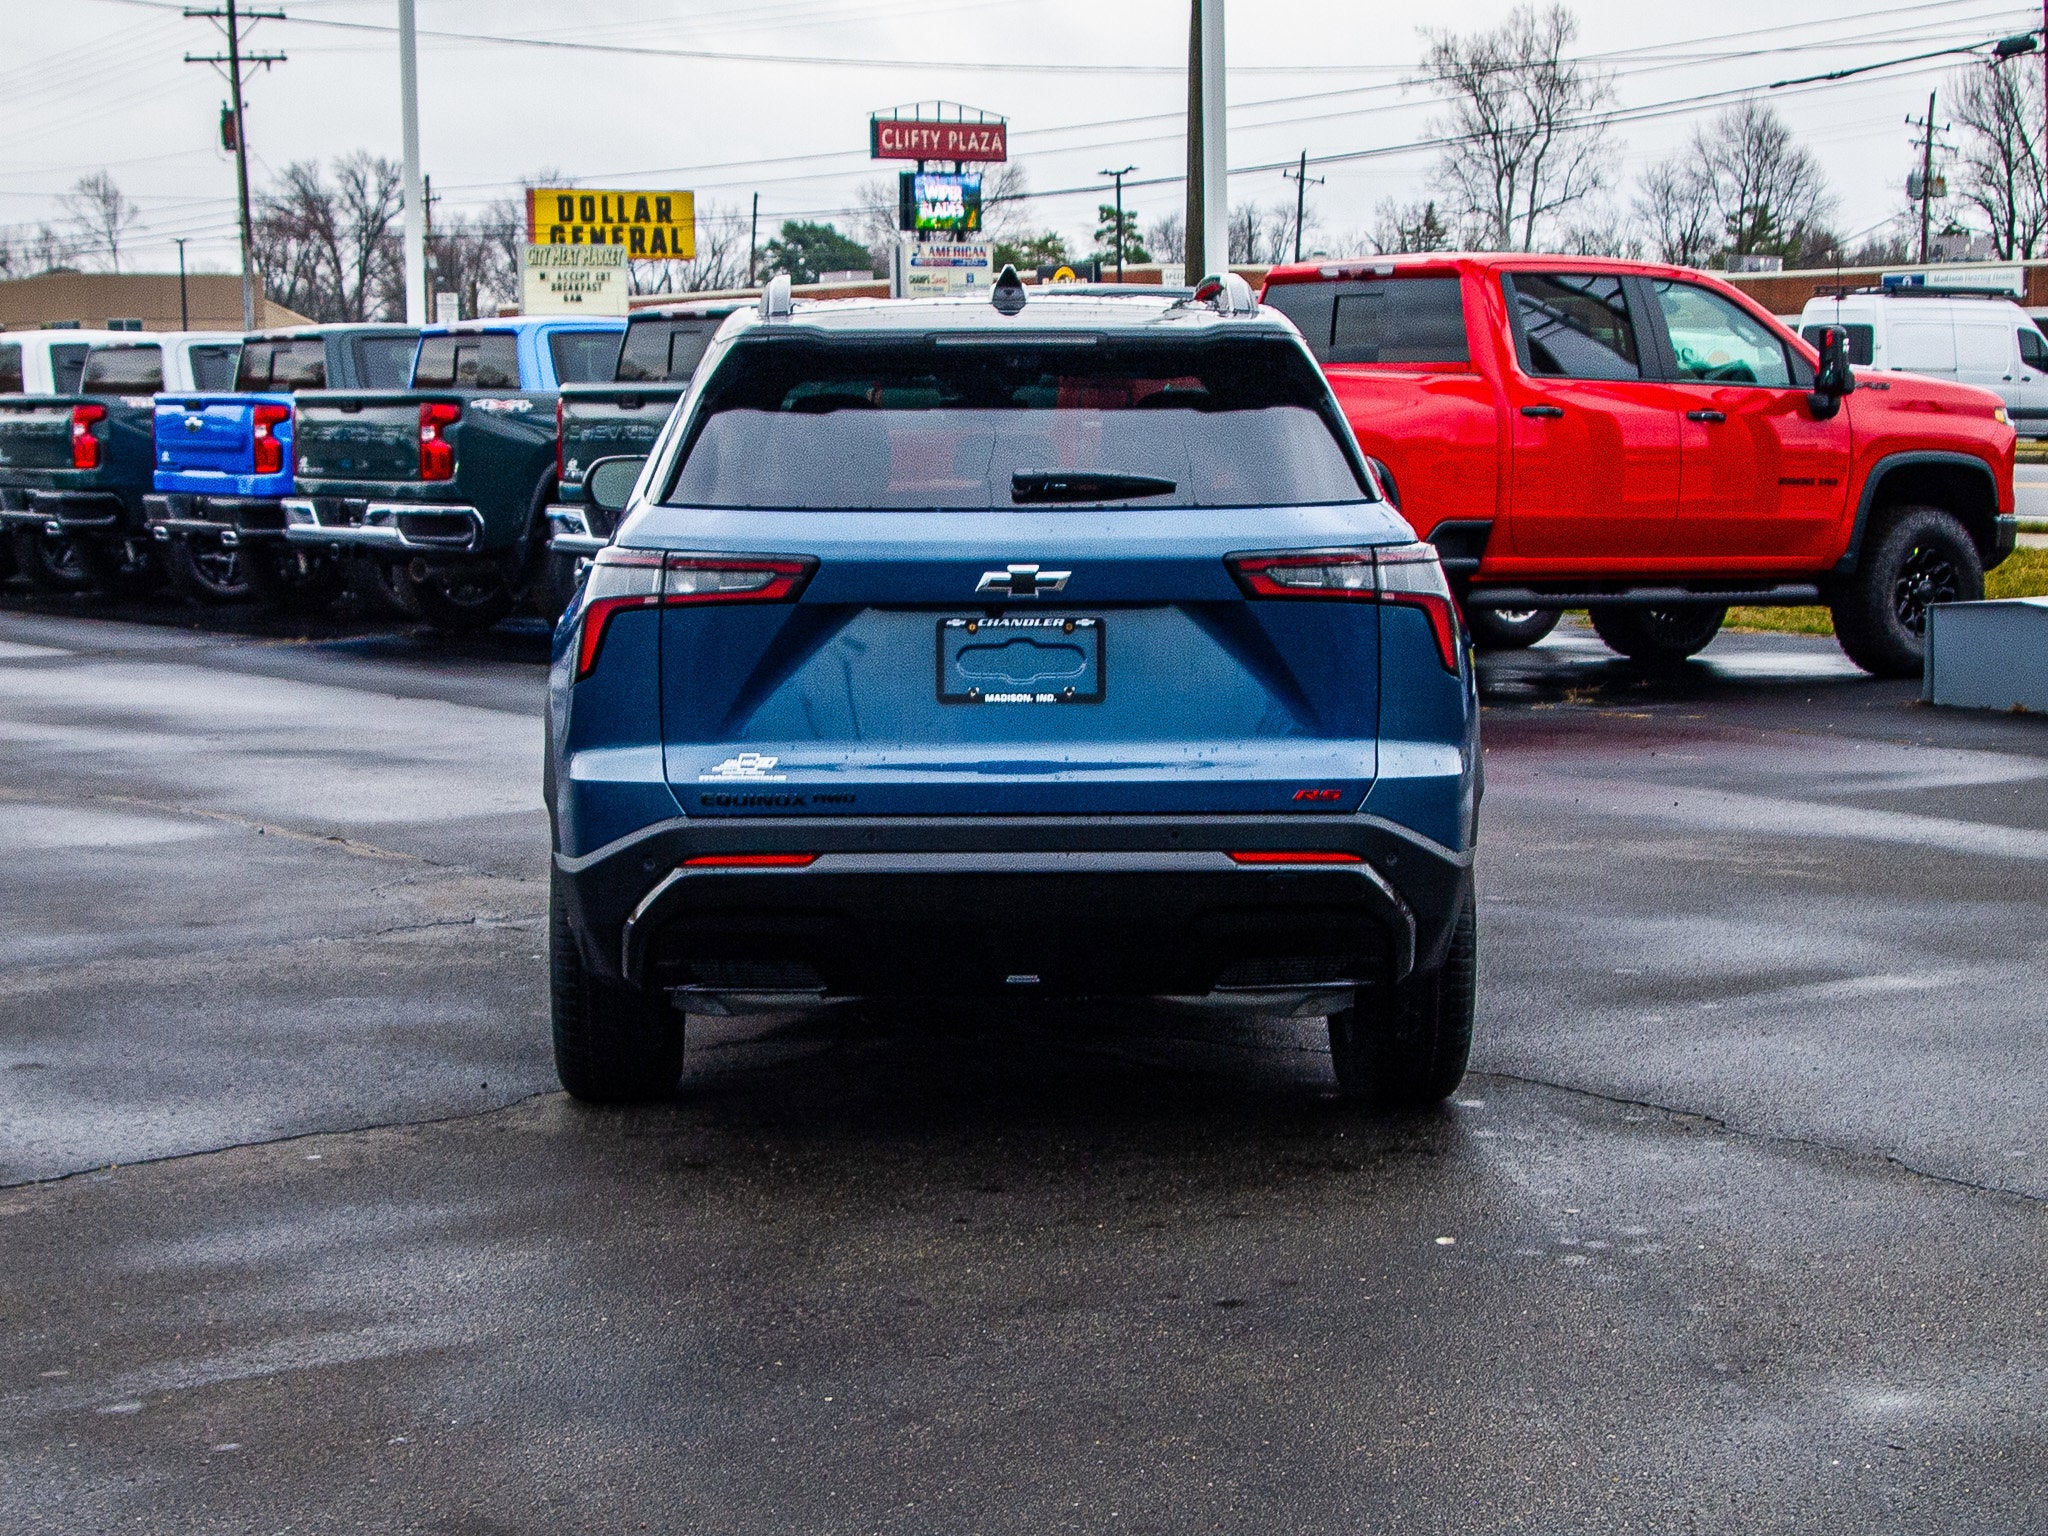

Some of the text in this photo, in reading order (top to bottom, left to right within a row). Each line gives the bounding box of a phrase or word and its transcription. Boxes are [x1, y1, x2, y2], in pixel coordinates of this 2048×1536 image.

[881, 128, 1002, 152] CLIFTY PLAZA
[557, 194, 672, 224] DOLLAR
[550, 225, 683, 254] GENERAL
[929, 245, 987, 257] AMERICAN
[557, 271, 590, 281] ACCEPT
[551, 282, 602, 292] BREAKFAST
[977, 618, 1065, 627] CHANDLER
[1036, 693, 1057, 703] IND.
[700, 793, 856, 806] EQUINOX AWD
[1292, 789, 1341, 801] RS
